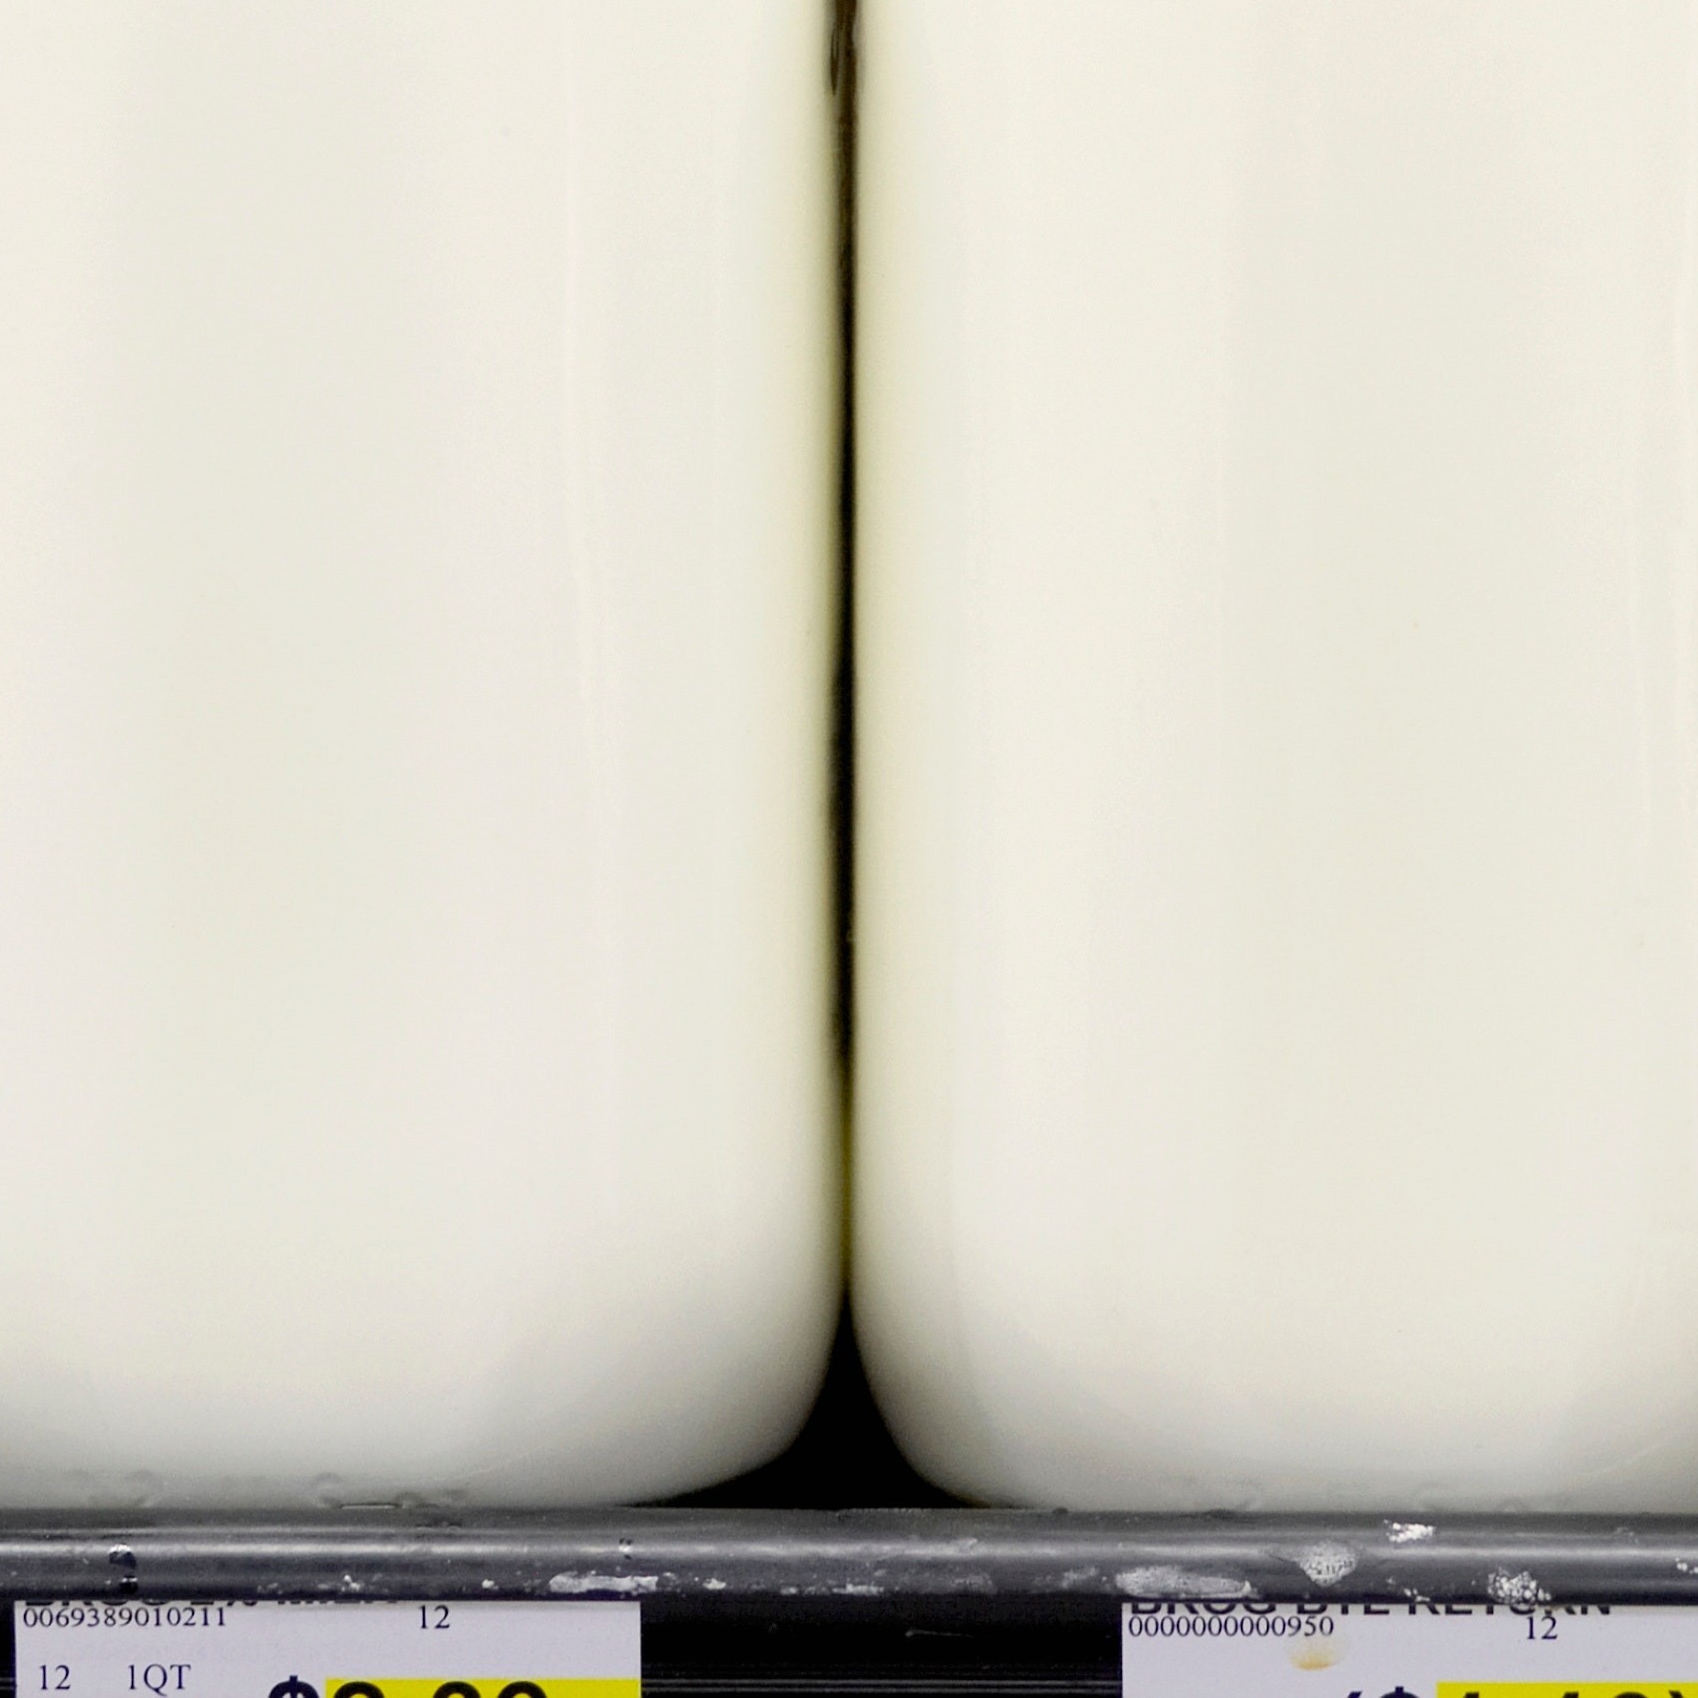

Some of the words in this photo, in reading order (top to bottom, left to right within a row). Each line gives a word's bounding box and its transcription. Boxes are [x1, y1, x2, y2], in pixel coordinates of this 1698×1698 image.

[22, 1607, 227, 1628] 0069389010211
[418, 1606, 451, 1630] 12
[1128, 1615, 1335, 1637] 0000000000950
[1526, 1616, 1558, 1640] 12
[38, 1664, 72, 1690] 12
[128, 1663, 192, 1696] 1QT
